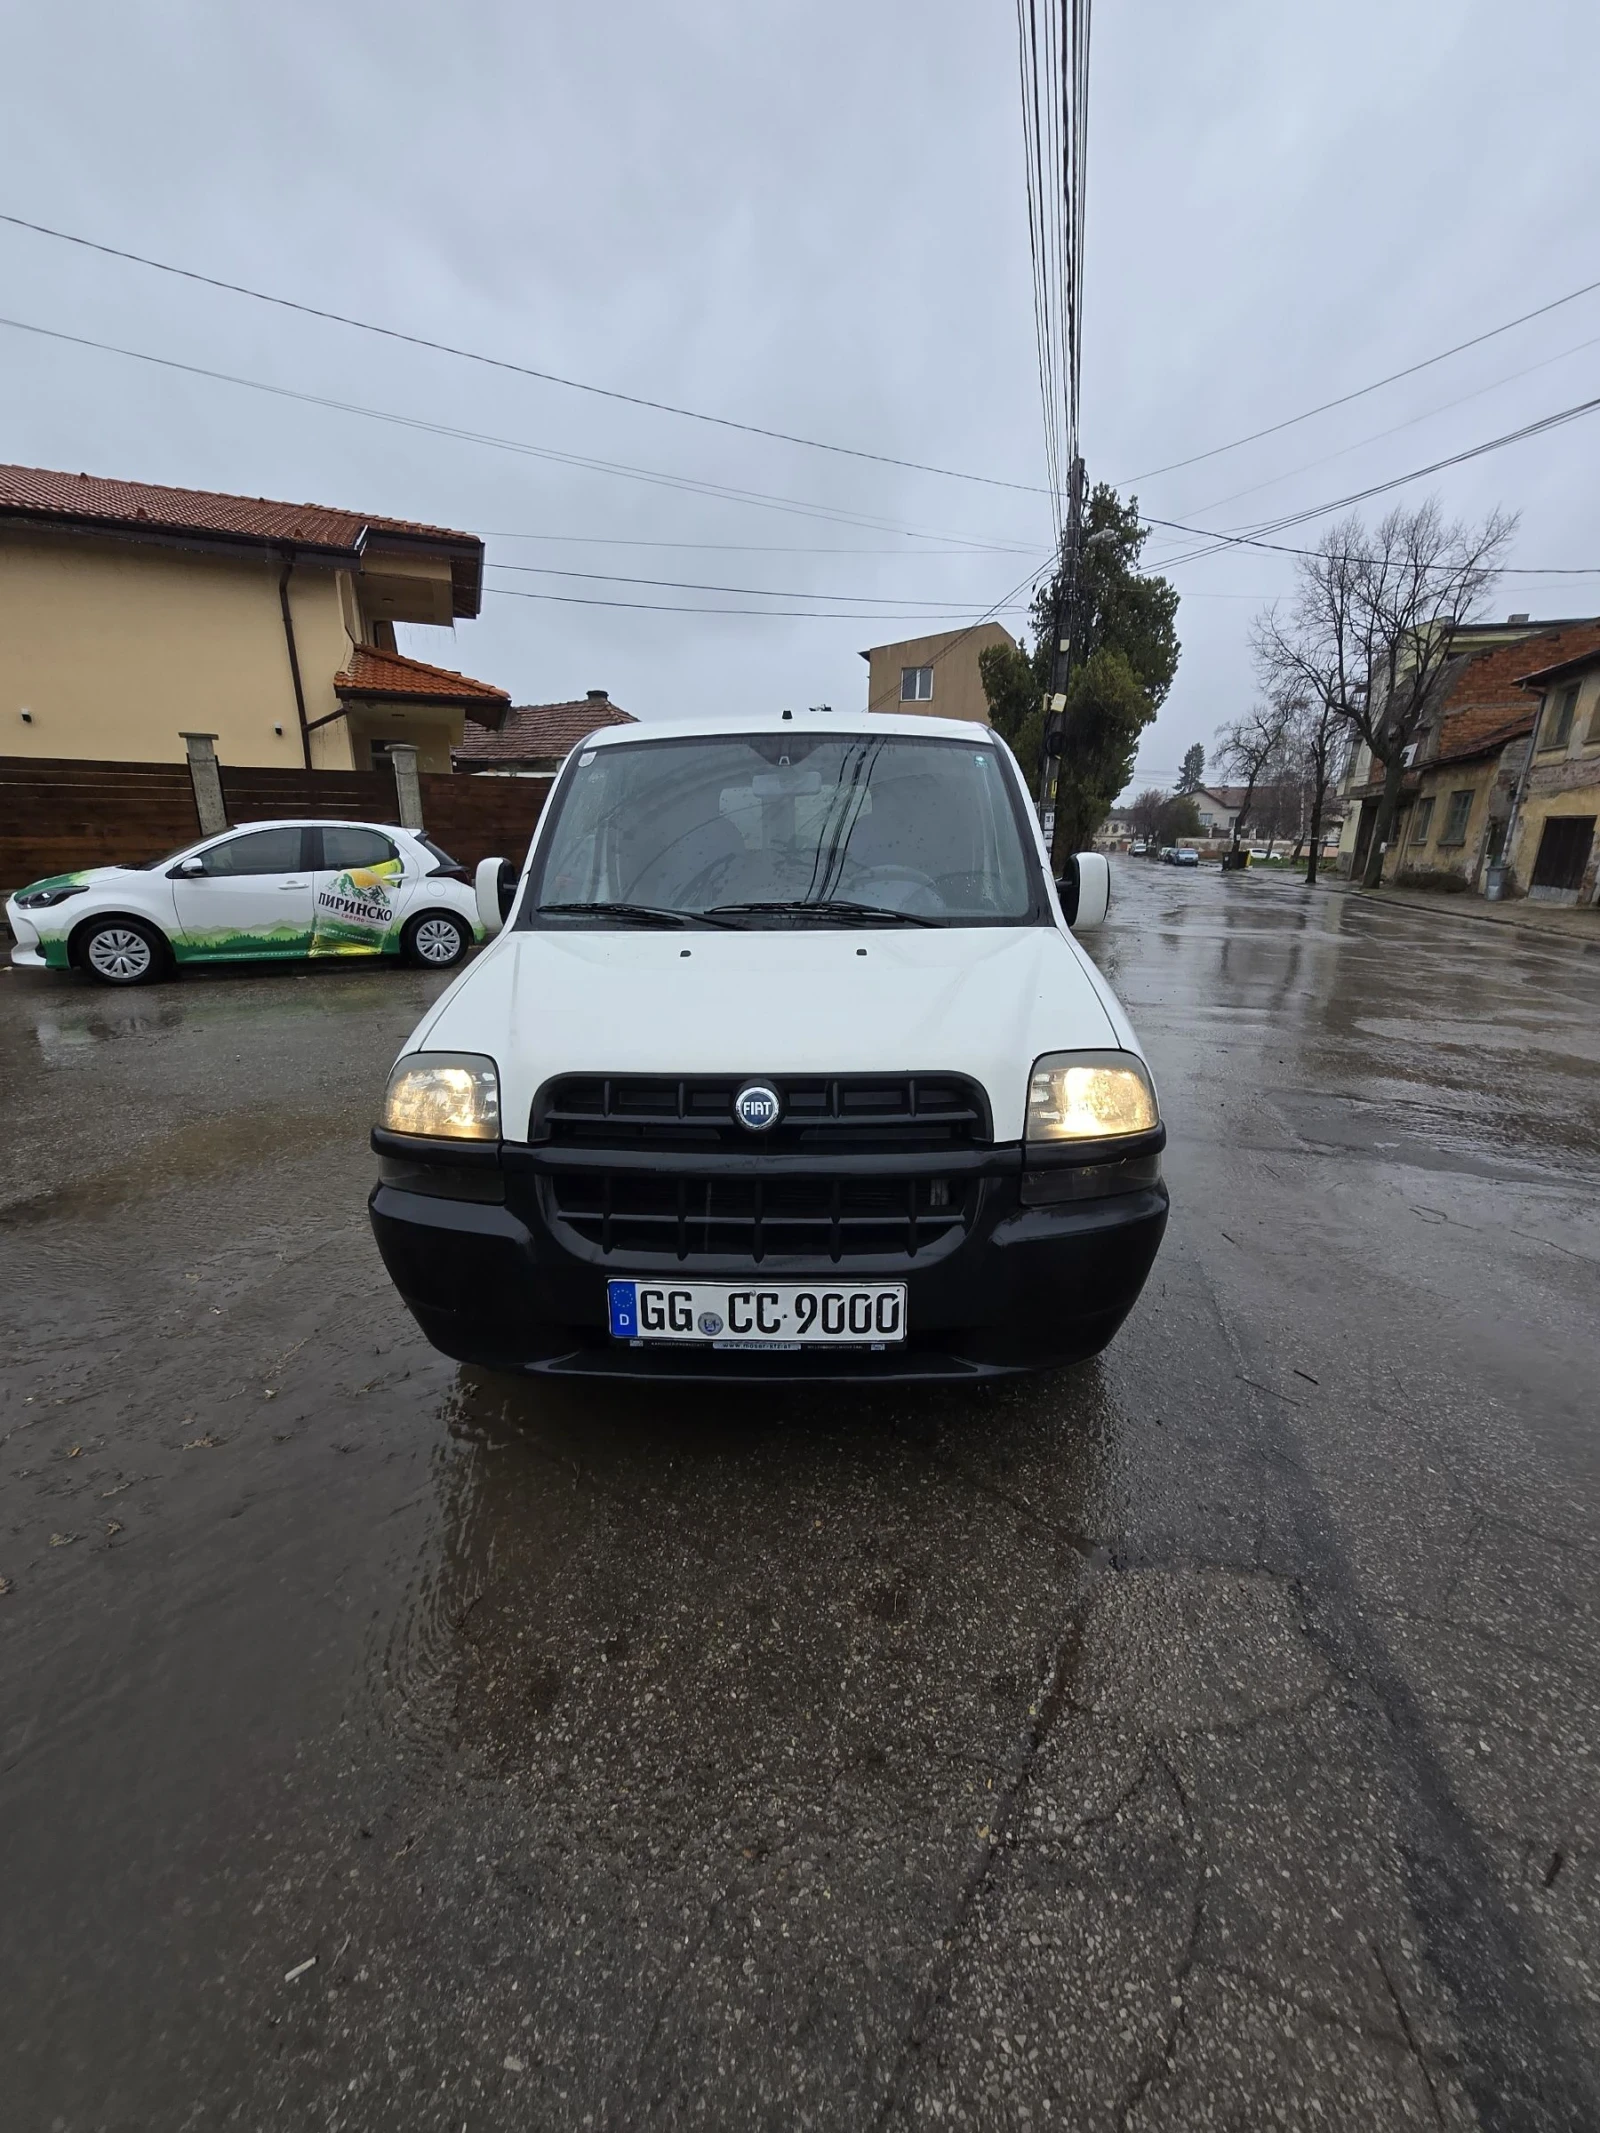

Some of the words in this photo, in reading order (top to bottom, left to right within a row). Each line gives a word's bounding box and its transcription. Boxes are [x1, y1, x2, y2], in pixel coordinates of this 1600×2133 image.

[318, 892, 393, 922] ПИРИНСКО
[743, 1101, 772, 1116] FIAT
[619, 1313, 630, 1326] D
[640, 1290, 693, 1332] GG
[728, 1292, 782, 1334] CC
[795, 1292, 900, 1335] 9000
